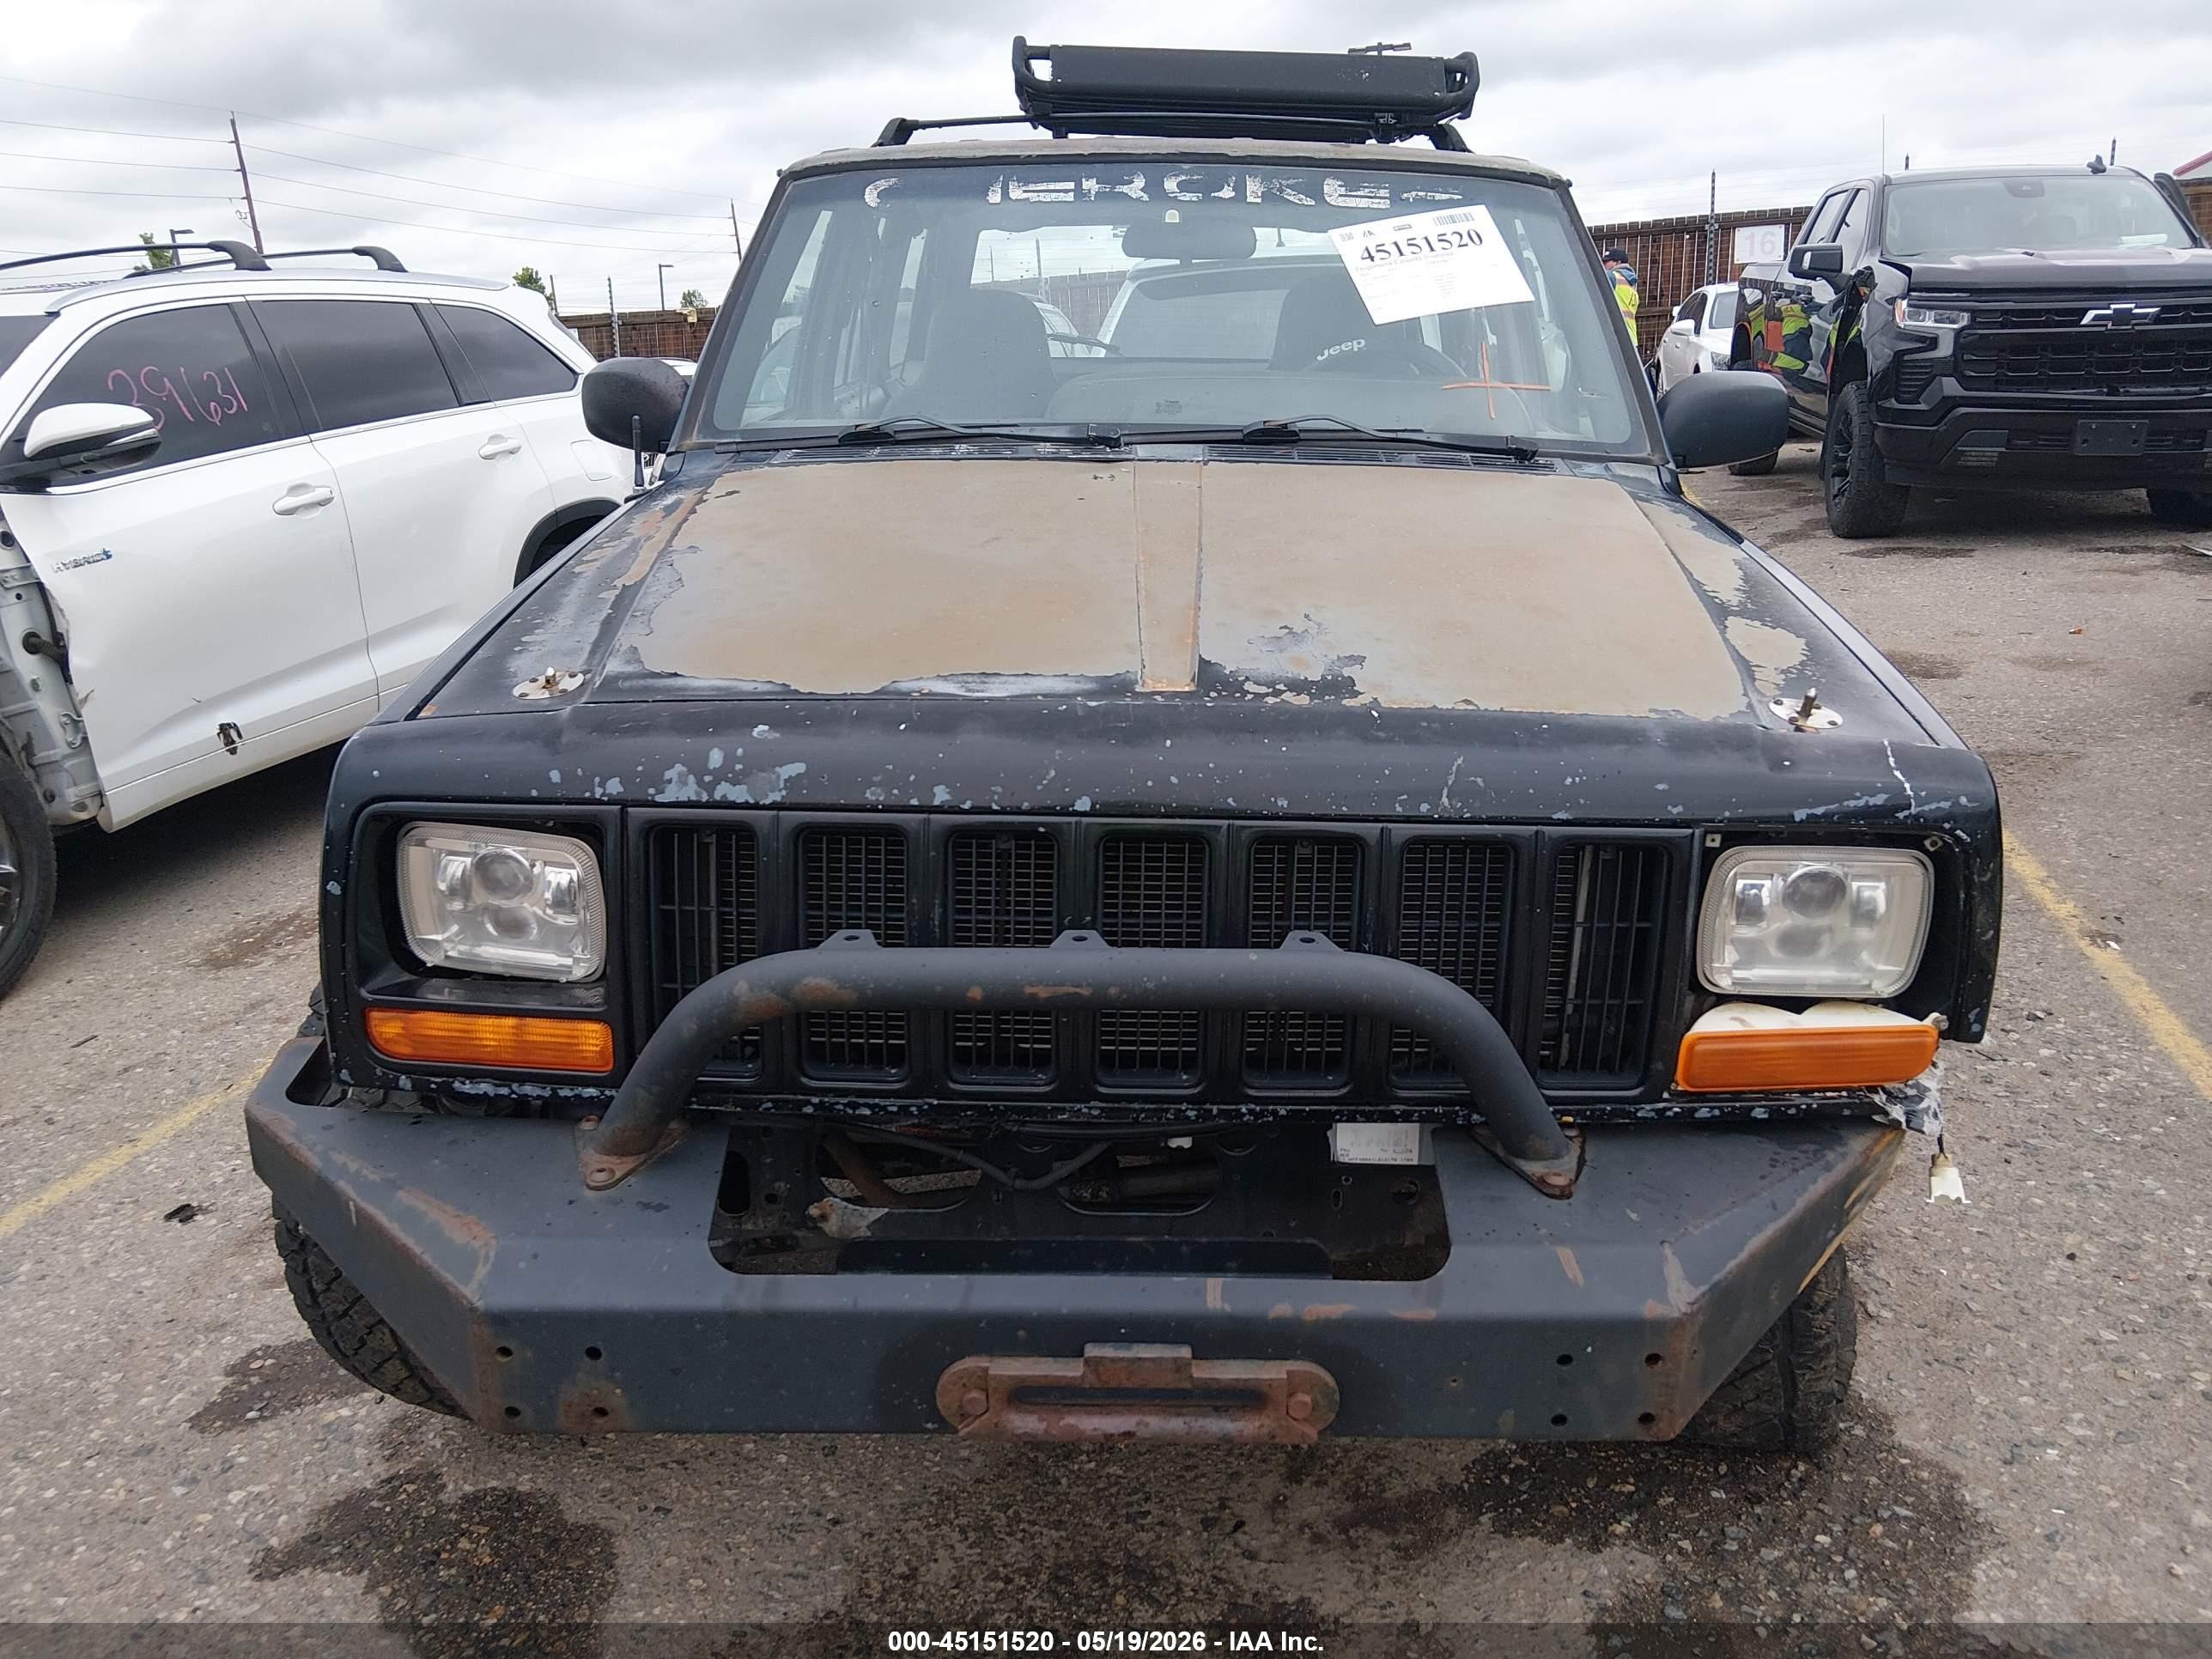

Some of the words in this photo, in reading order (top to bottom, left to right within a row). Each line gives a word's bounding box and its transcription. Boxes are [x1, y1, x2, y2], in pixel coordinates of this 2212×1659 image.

[864, 172, 1463, 210] CEROKE
[1360, 228, 1483, 262] 45151520
[1745, 231, 1776, 256] 16
[1316, 339, 1365, 361] Jeep
